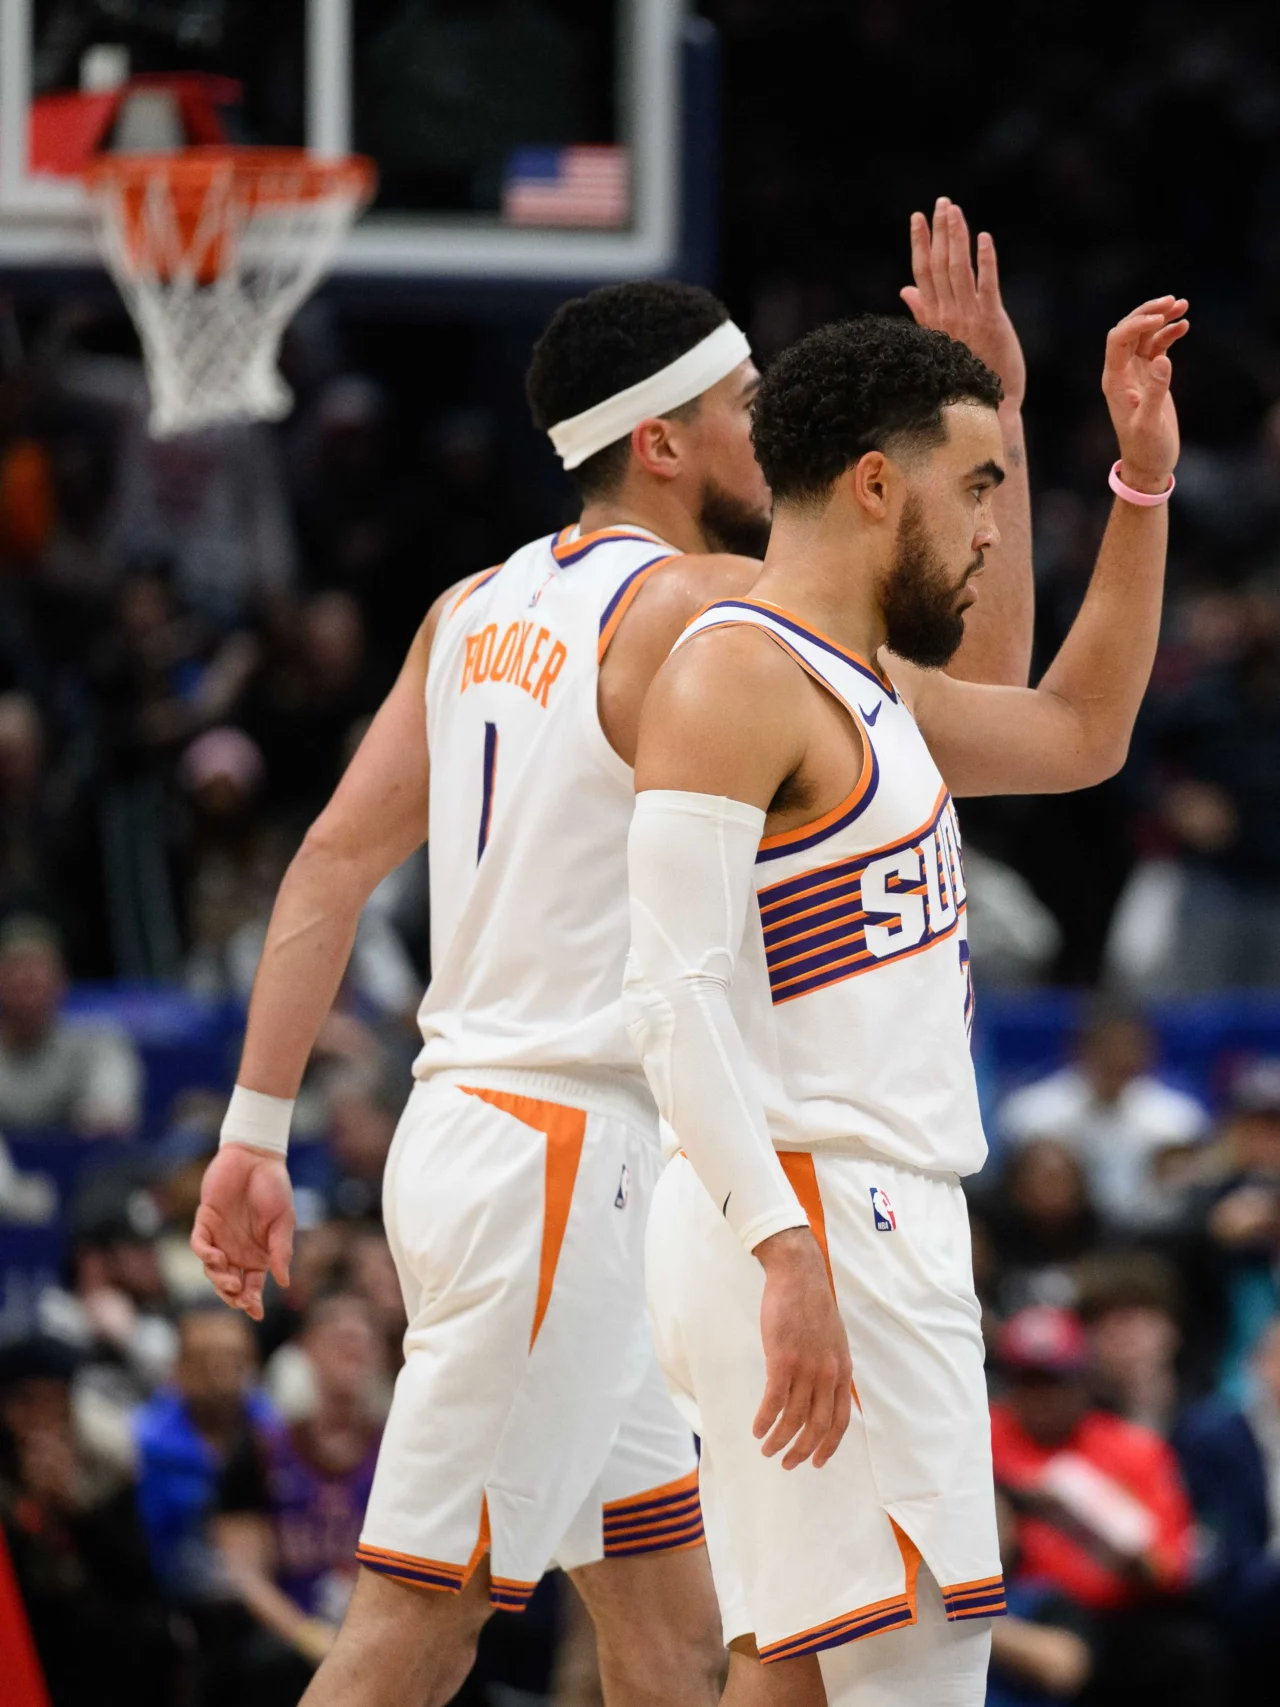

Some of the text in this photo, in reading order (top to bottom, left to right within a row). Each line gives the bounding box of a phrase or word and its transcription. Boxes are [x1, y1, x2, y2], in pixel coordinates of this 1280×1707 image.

[460, 620, 567, 709] BOOKER
[476, 720, 499, 869] 1
[860, 793, 967, 959] SUN
